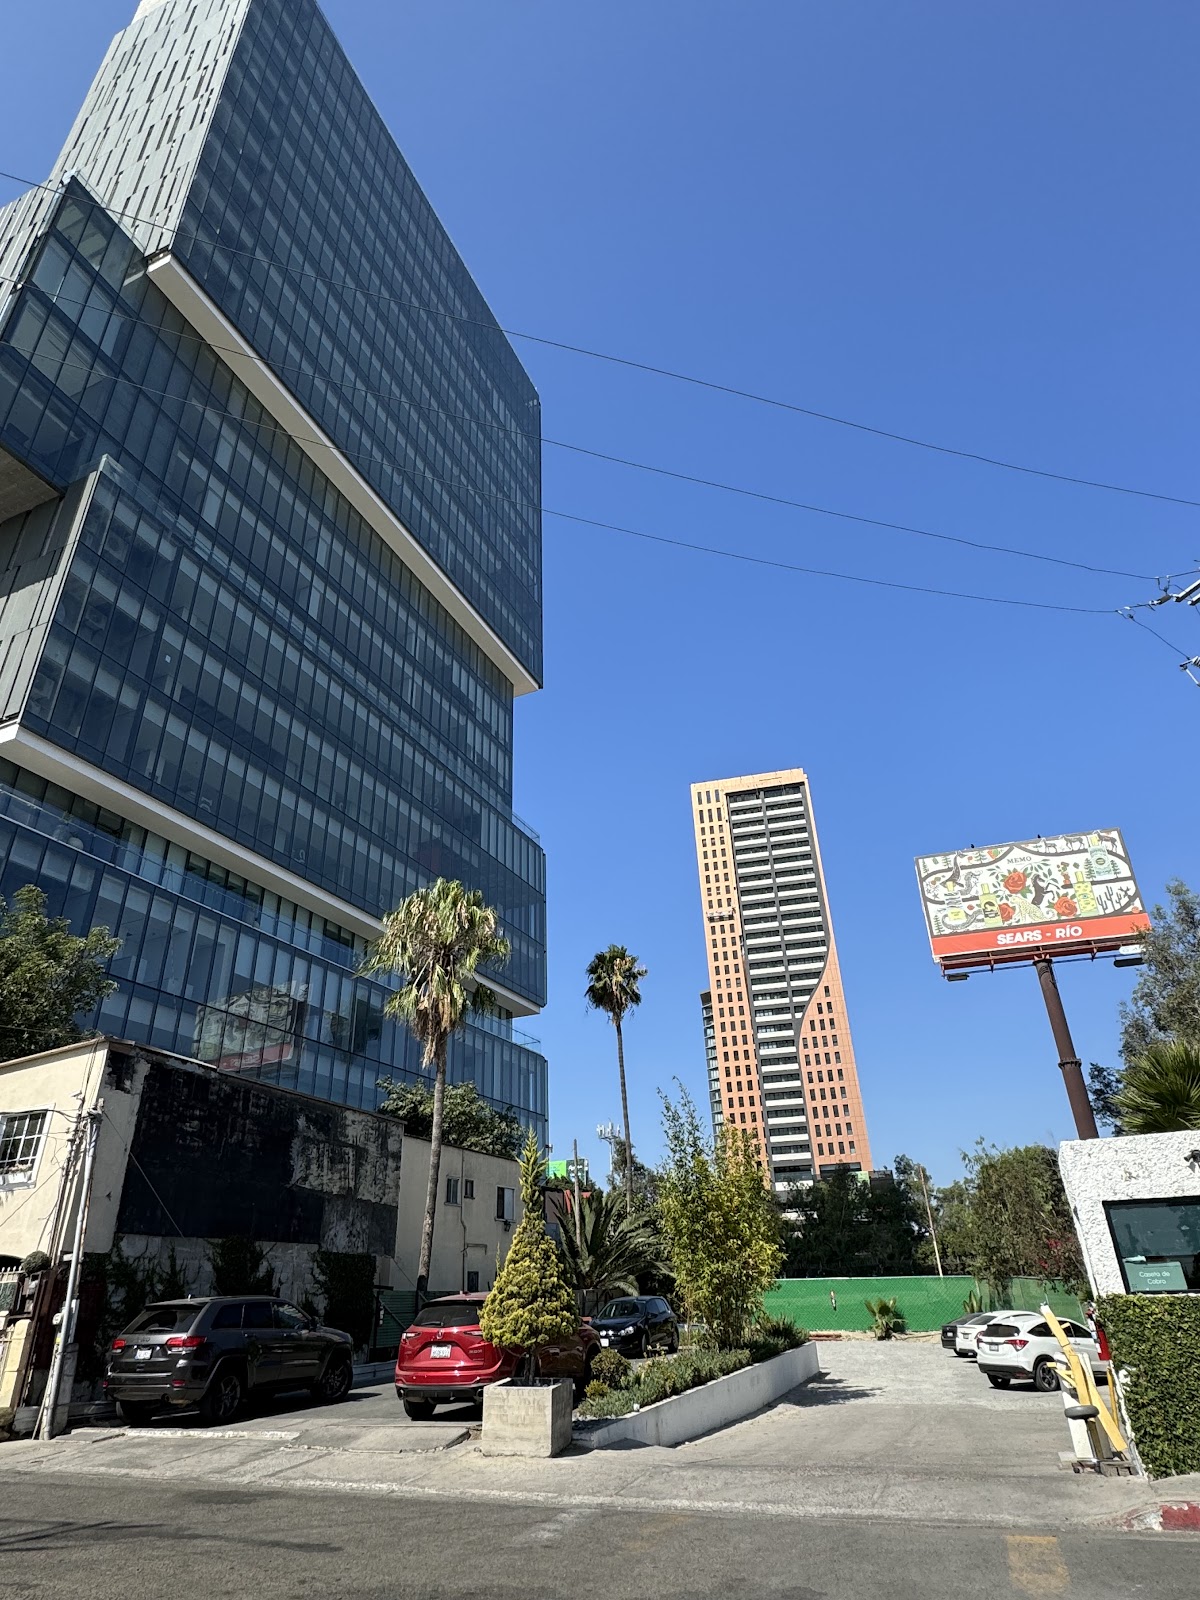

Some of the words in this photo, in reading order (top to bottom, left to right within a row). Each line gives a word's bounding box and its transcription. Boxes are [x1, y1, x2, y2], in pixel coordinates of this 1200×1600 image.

[1006, 856, 1032, 864] MEMO
[997, 930, 1042, 944] SEARS
[1056, 925, 1082, 938] RÍO
